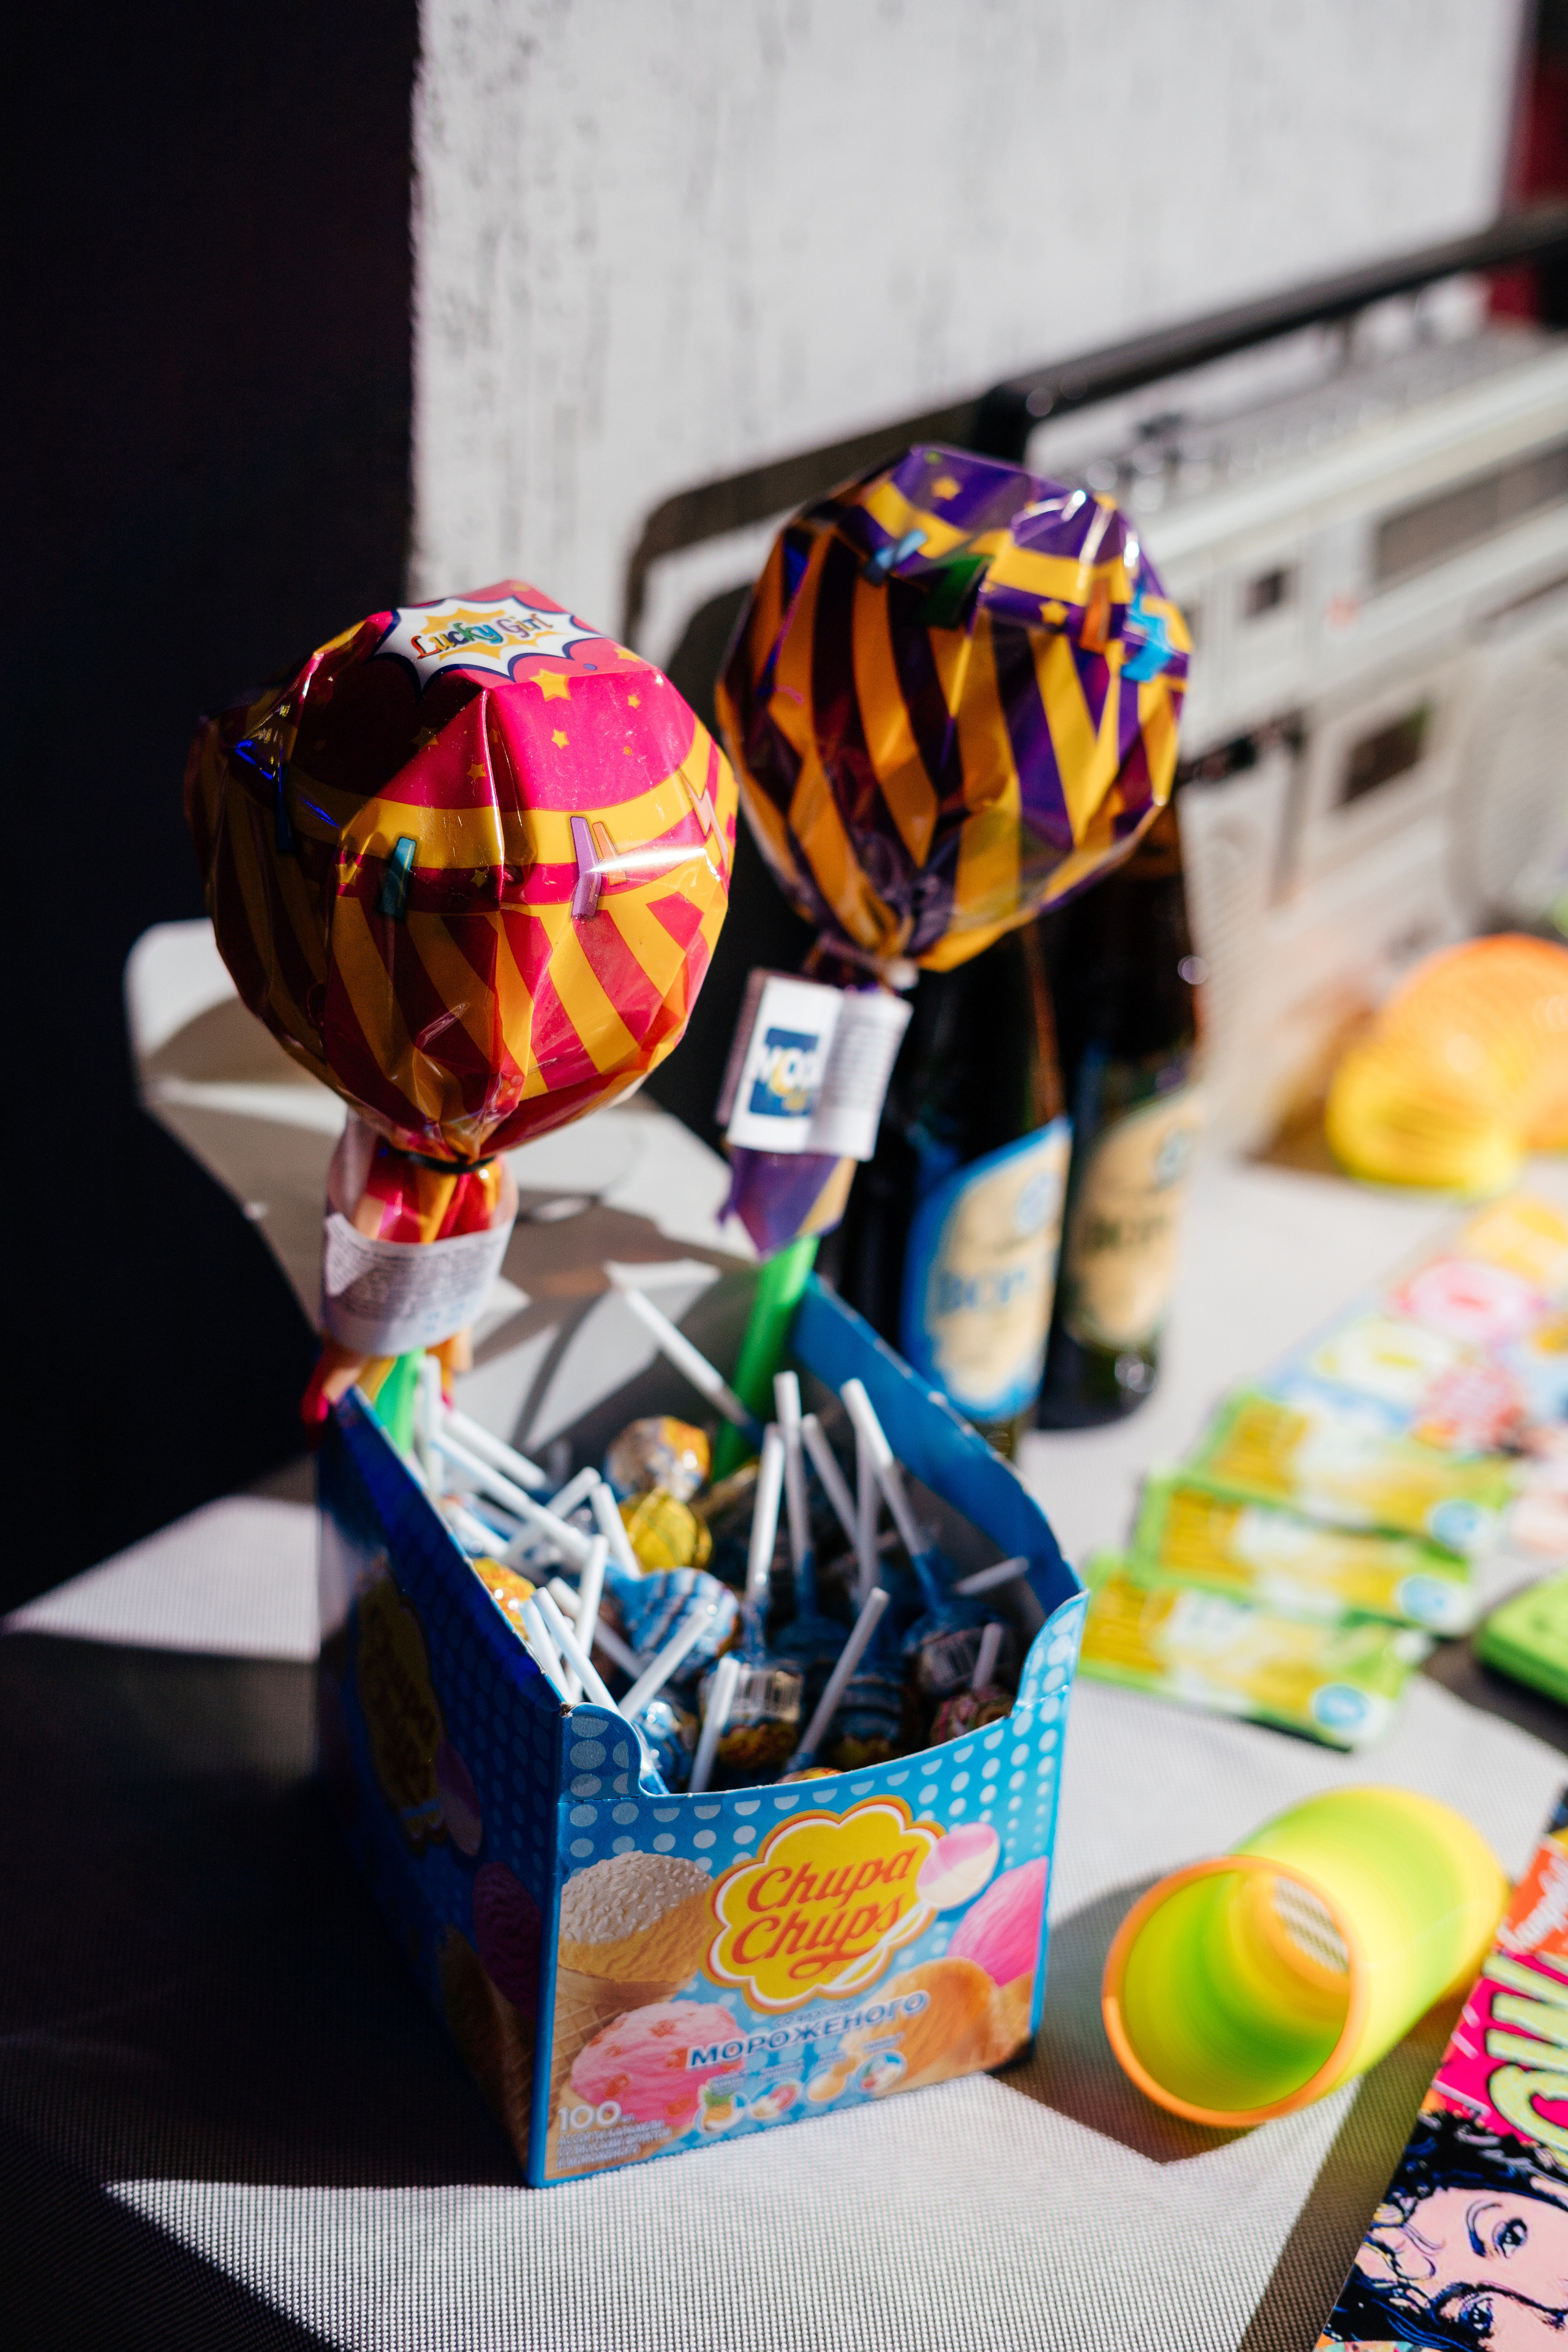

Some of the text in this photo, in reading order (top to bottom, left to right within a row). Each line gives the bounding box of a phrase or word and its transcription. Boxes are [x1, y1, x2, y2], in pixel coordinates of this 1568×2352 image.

[410, 613, 553, 660] Lucky Girl
[747, 1844, 919, 1912] Chupa
[731, 1893, 905, 1980] Chups
[688, 1991, 930, 2070] МОРОЖЕНОГО
[557, 2100, 622, 2133] 100
